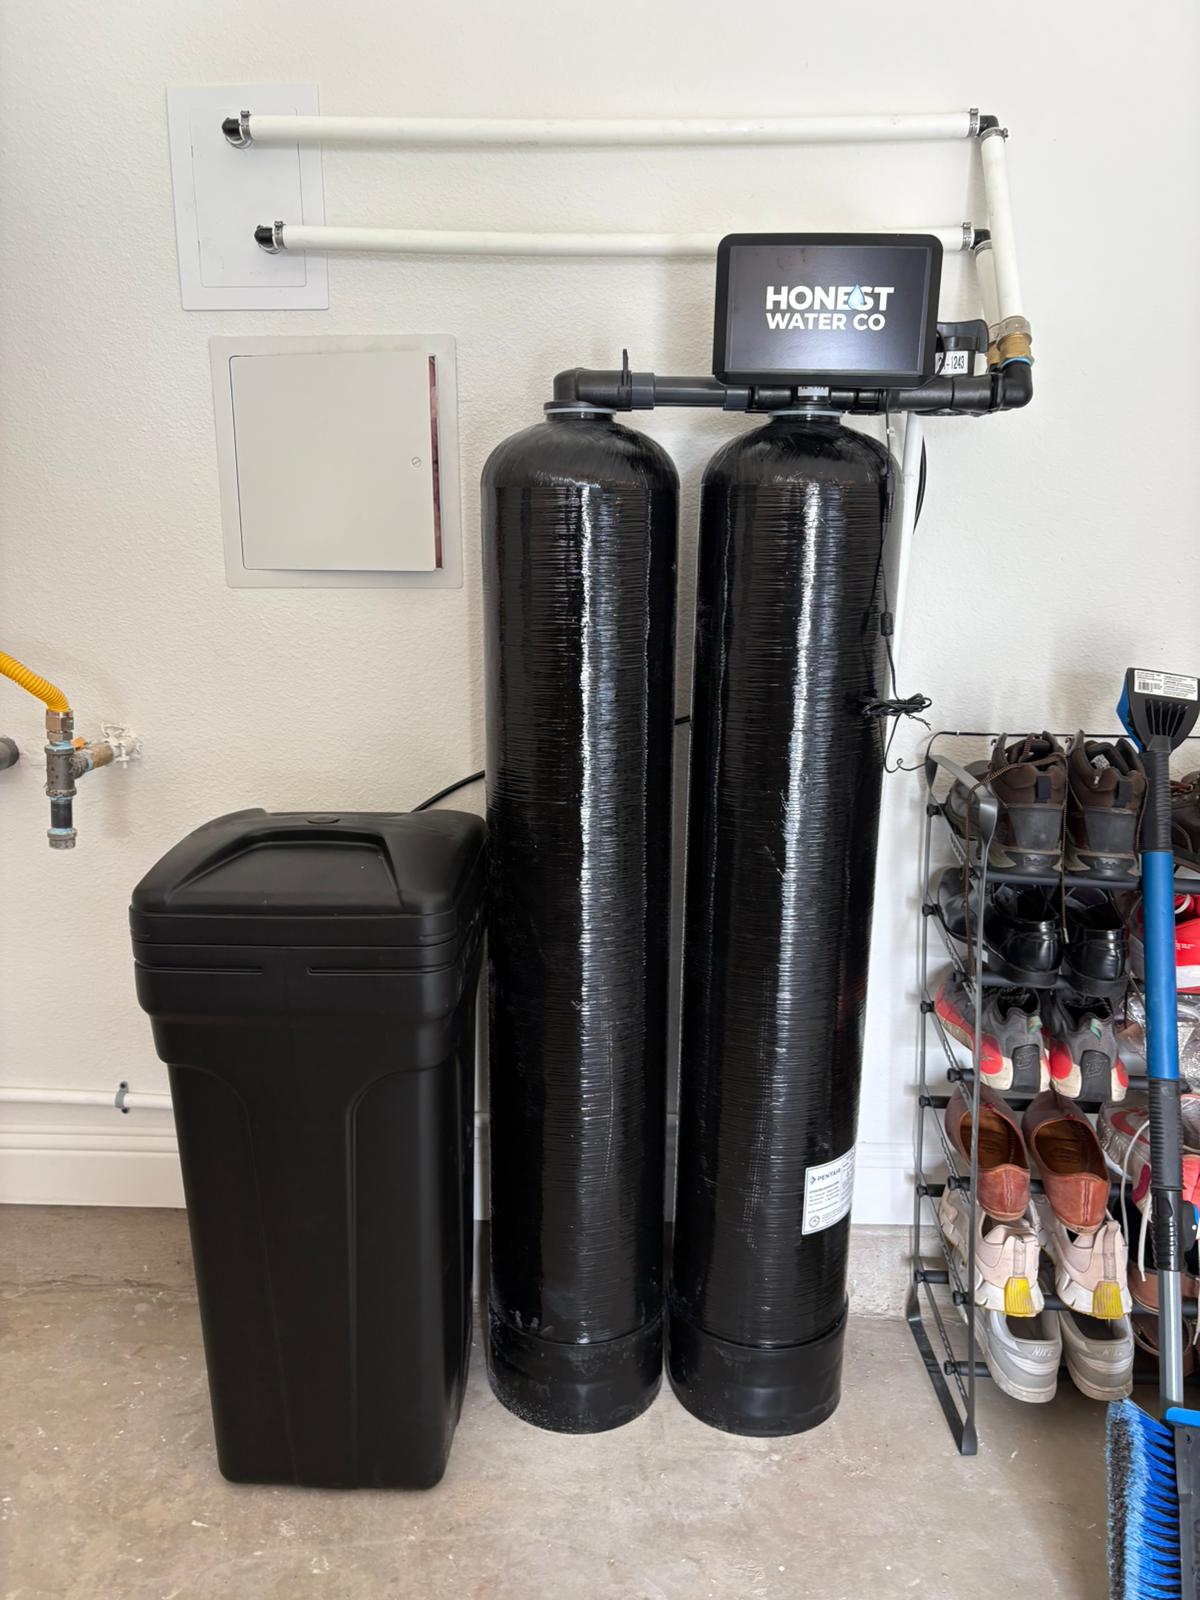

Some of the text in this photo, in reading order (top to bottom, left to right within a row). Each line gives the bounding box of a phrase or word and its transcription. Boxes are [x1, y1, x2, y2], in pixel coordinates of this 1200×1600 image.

[766, 285, 895, 311] HONEST
[766, 312, 886, 331] WATER CO
